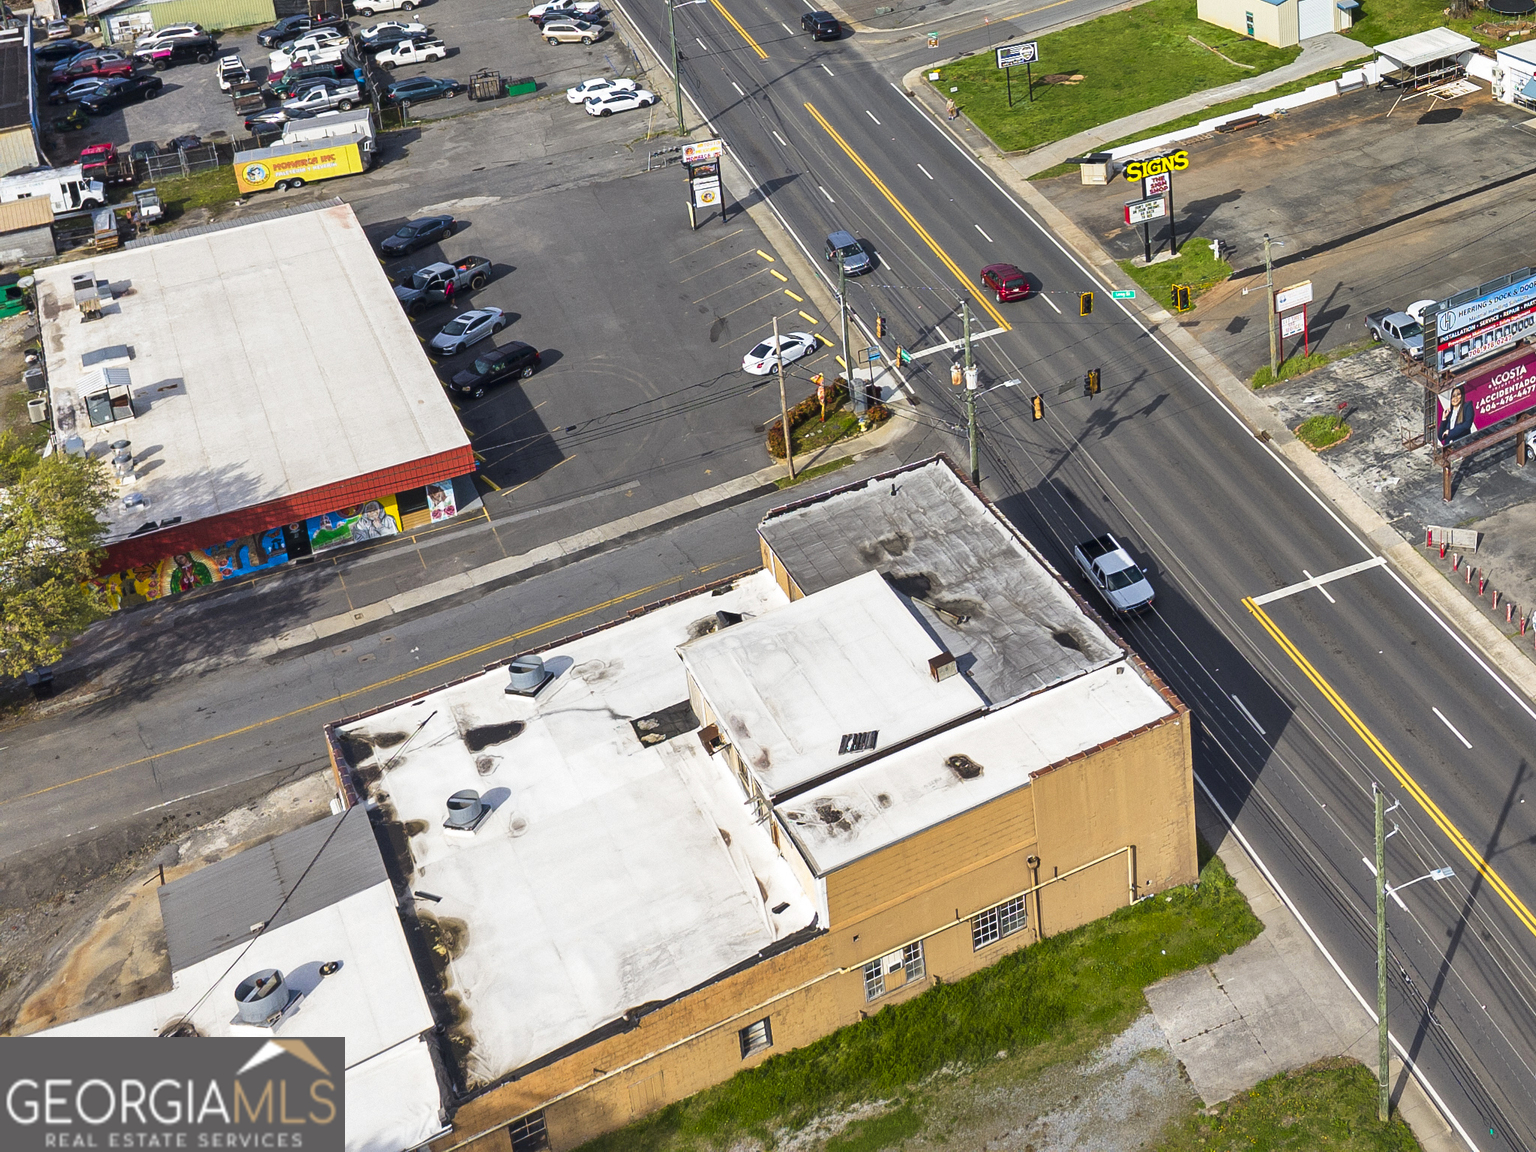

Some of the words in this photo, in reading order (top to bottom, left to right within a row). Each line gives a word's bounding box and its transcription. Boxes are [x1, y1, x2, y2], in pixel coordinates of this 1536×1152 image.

[273, 157, 318, 171] MONARCA
[321, 154, 336, 162] INC
[275, 167, 306, 177] PALETERIA
[1126, 151, 1189, 182] SIGNS
[1149, 186, 1168, 194] SHOP
[1151, 175, 1165, 183] THE
[1458, 297, 1493, 318] HERRING'S
[1494, 293, 1512, 303] DOCK
[1439, 324, 1476, 344] INSTALLATION
[1479, 314, 1500, 327] SERVICE
[1503, 306, 1520, 318] REPAIR
[1488, 364, 1527, 389] ACOSTA
[1480, 384, 1536, 414] 404-476-4477
